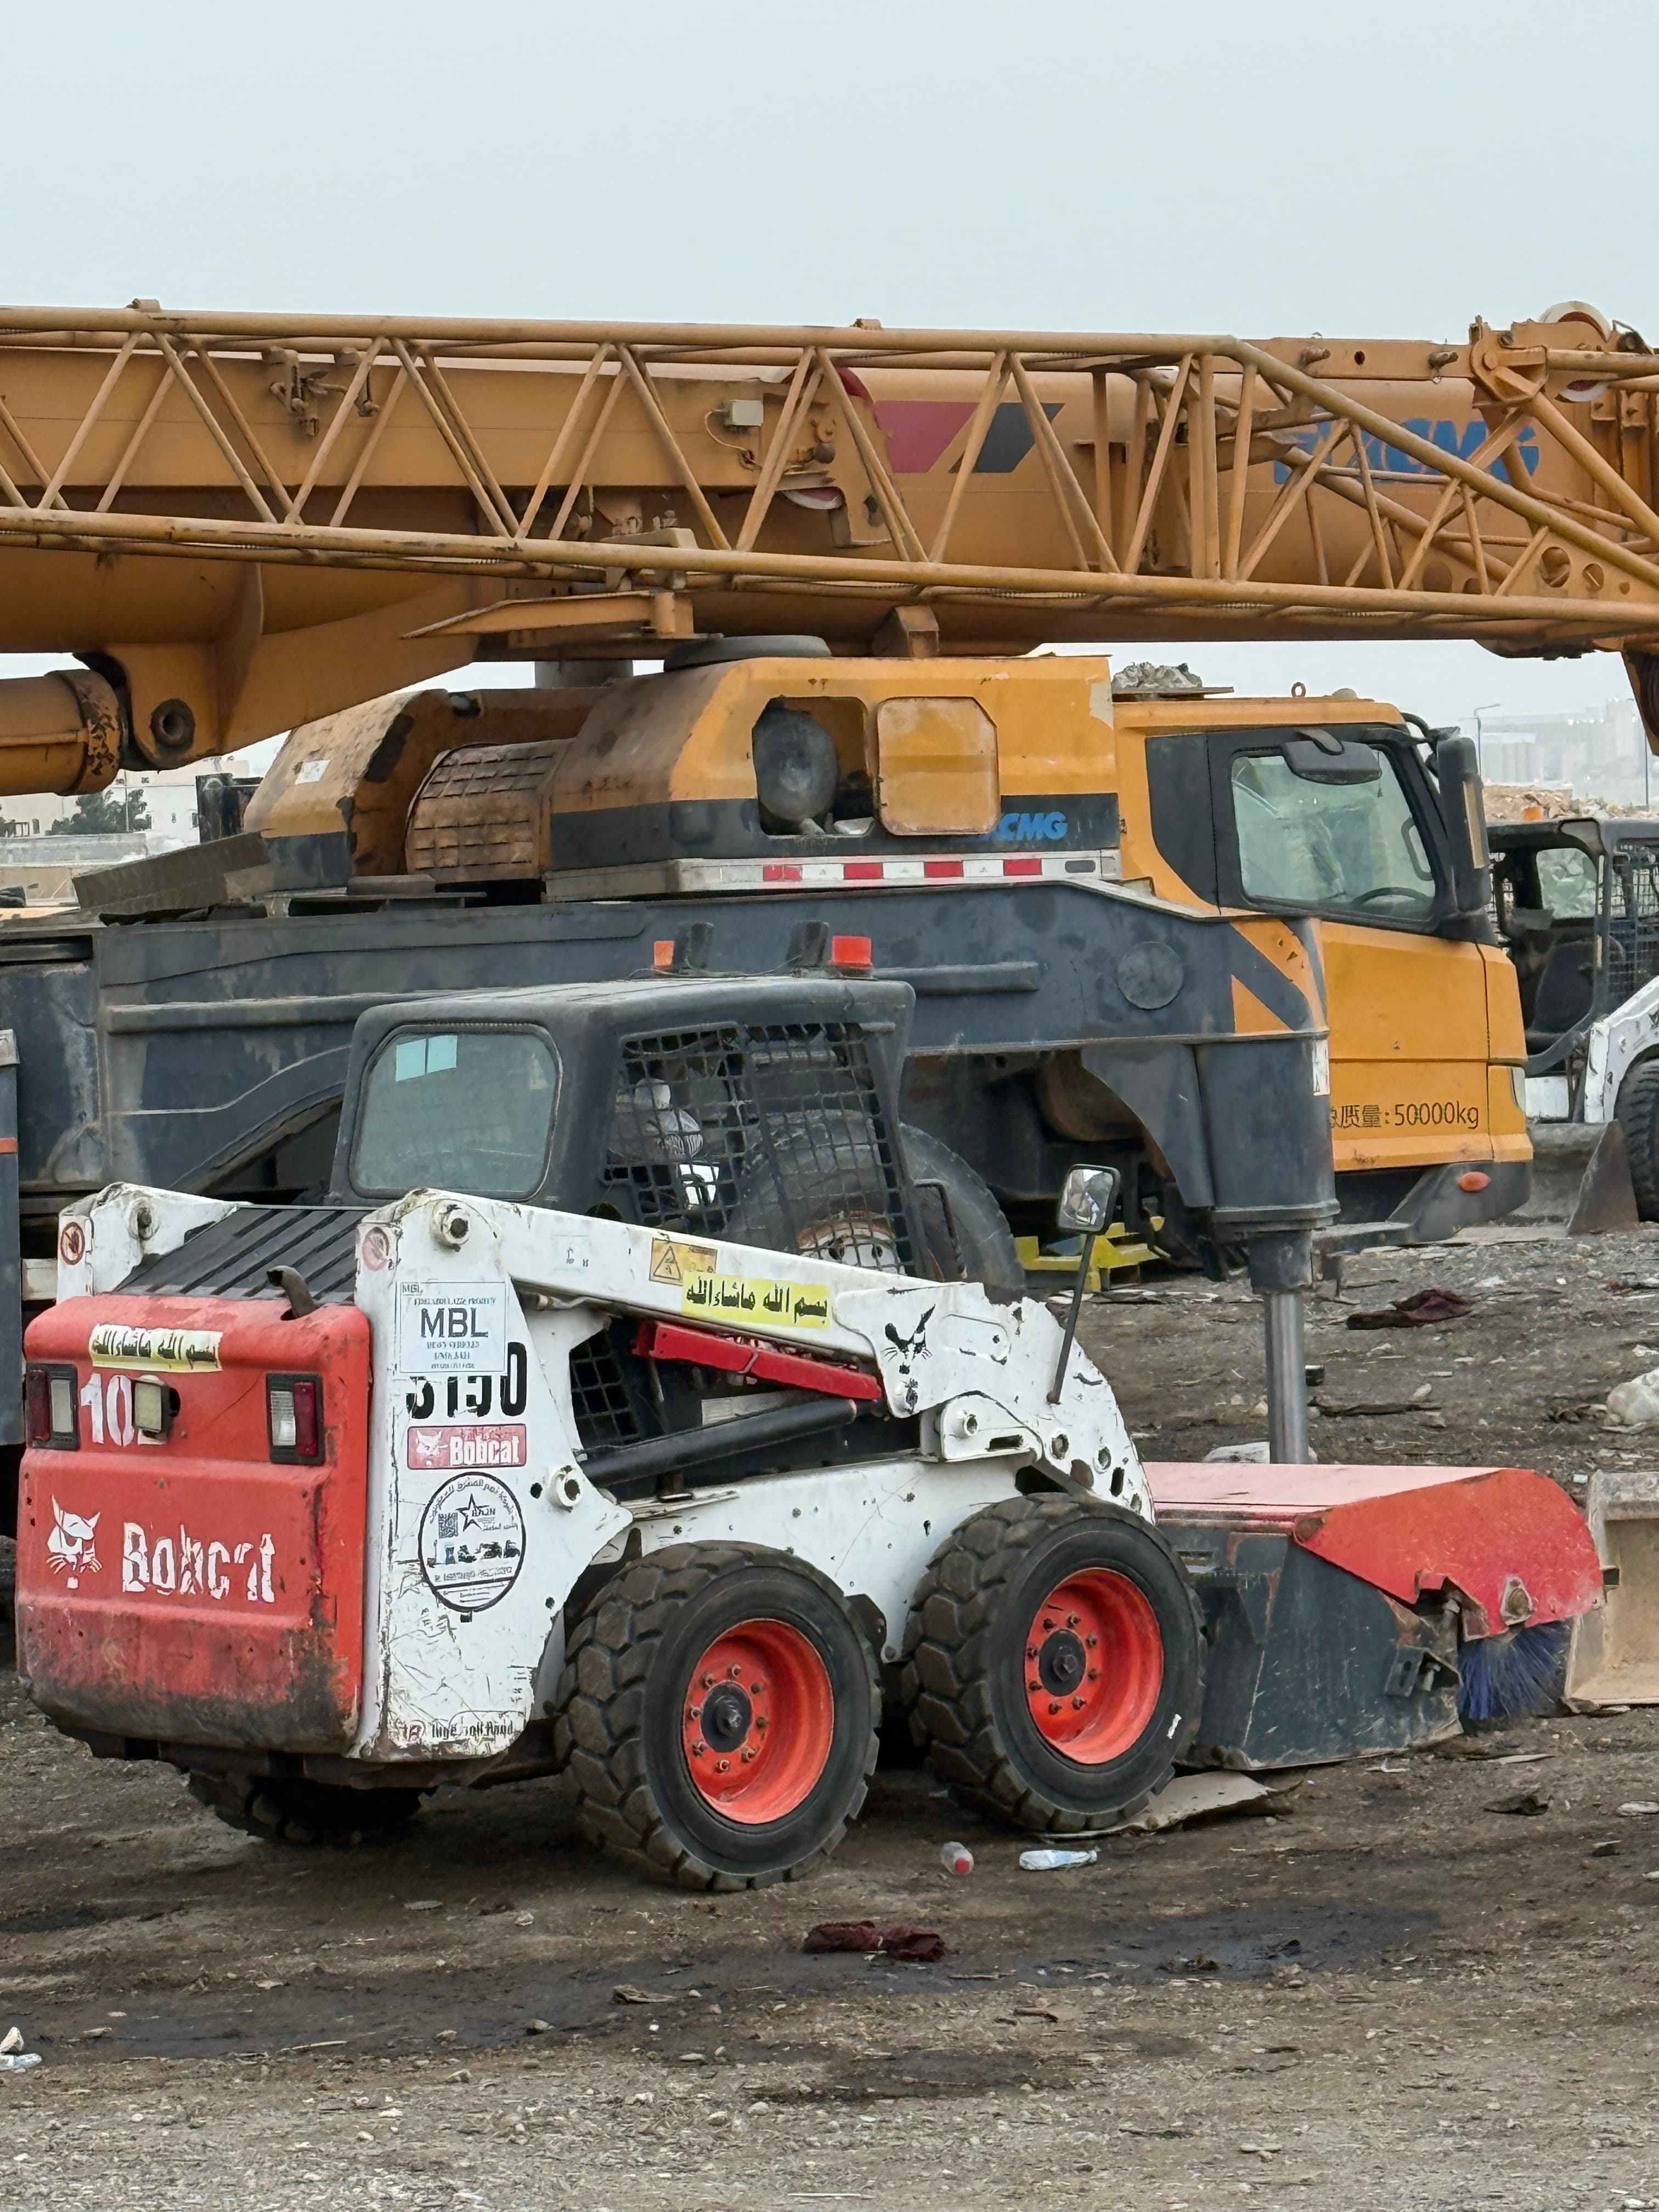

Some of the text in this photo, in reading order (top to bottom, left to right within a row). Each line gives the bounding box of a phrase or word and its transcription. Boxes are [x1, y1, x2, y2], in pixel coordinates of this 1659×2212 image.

[763, 1283, 790, 1313] الله
[794, 1295, 828, 1324] بسم
[421, 1307, 489, 1338] MBL
[80, 1373, 167, 1447] 10
[450, 1435, 520, 1465] Bobcat
